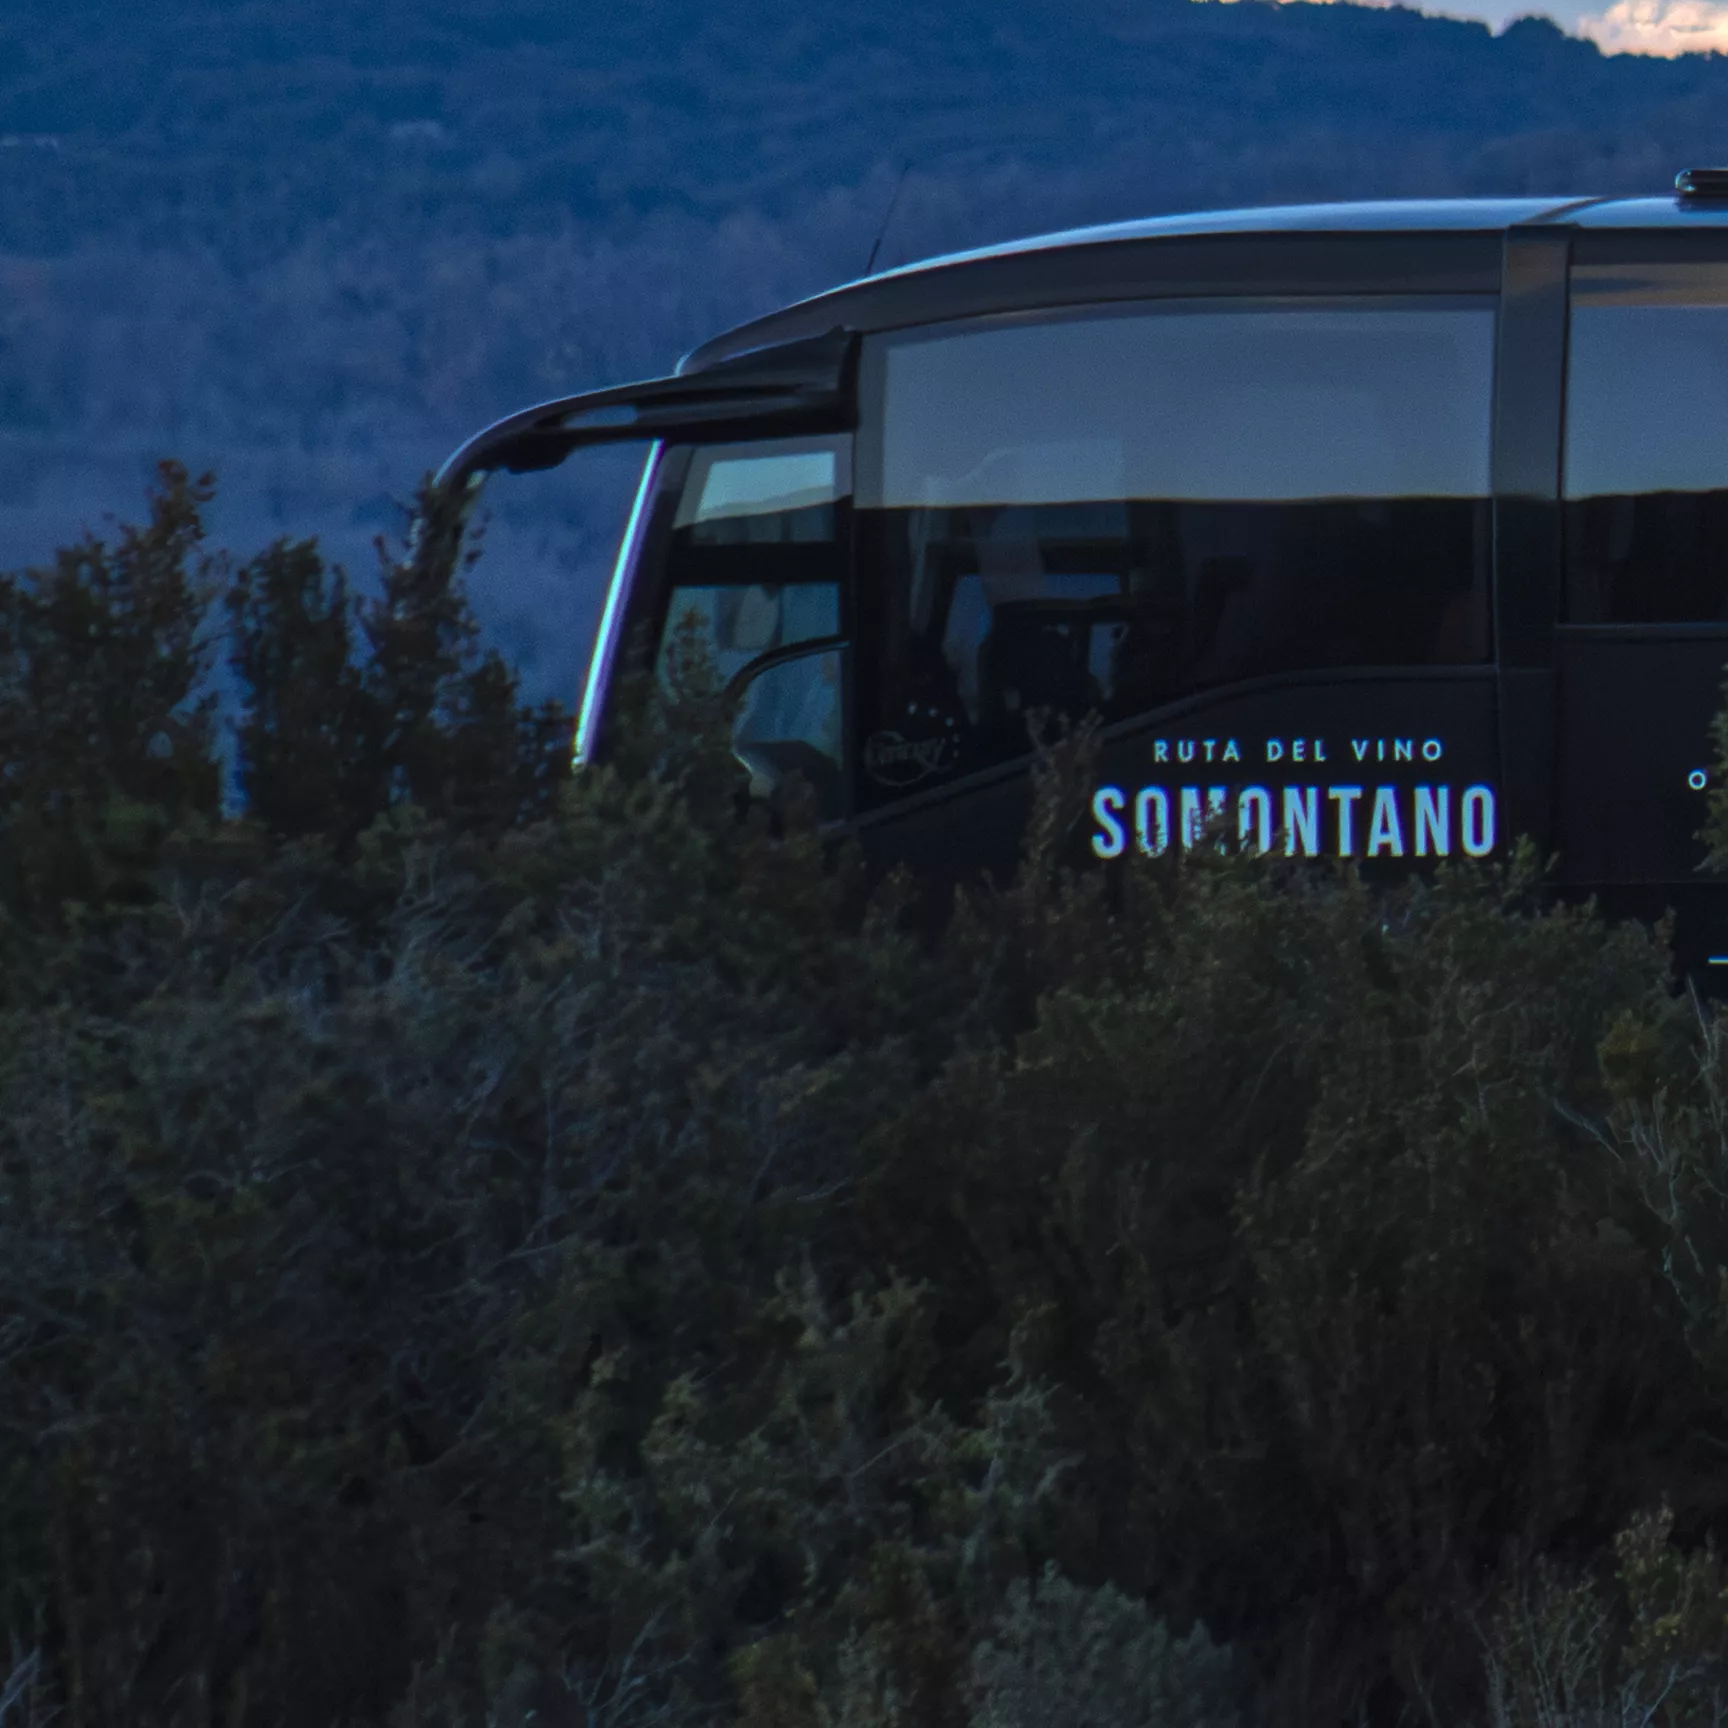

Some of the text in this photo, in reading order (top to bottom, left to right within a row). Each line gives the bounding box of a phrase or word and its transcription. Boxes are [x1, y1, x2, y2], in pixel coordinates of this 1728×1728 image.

[1155, 738, 1442, 761] RUTA DEL VINO
